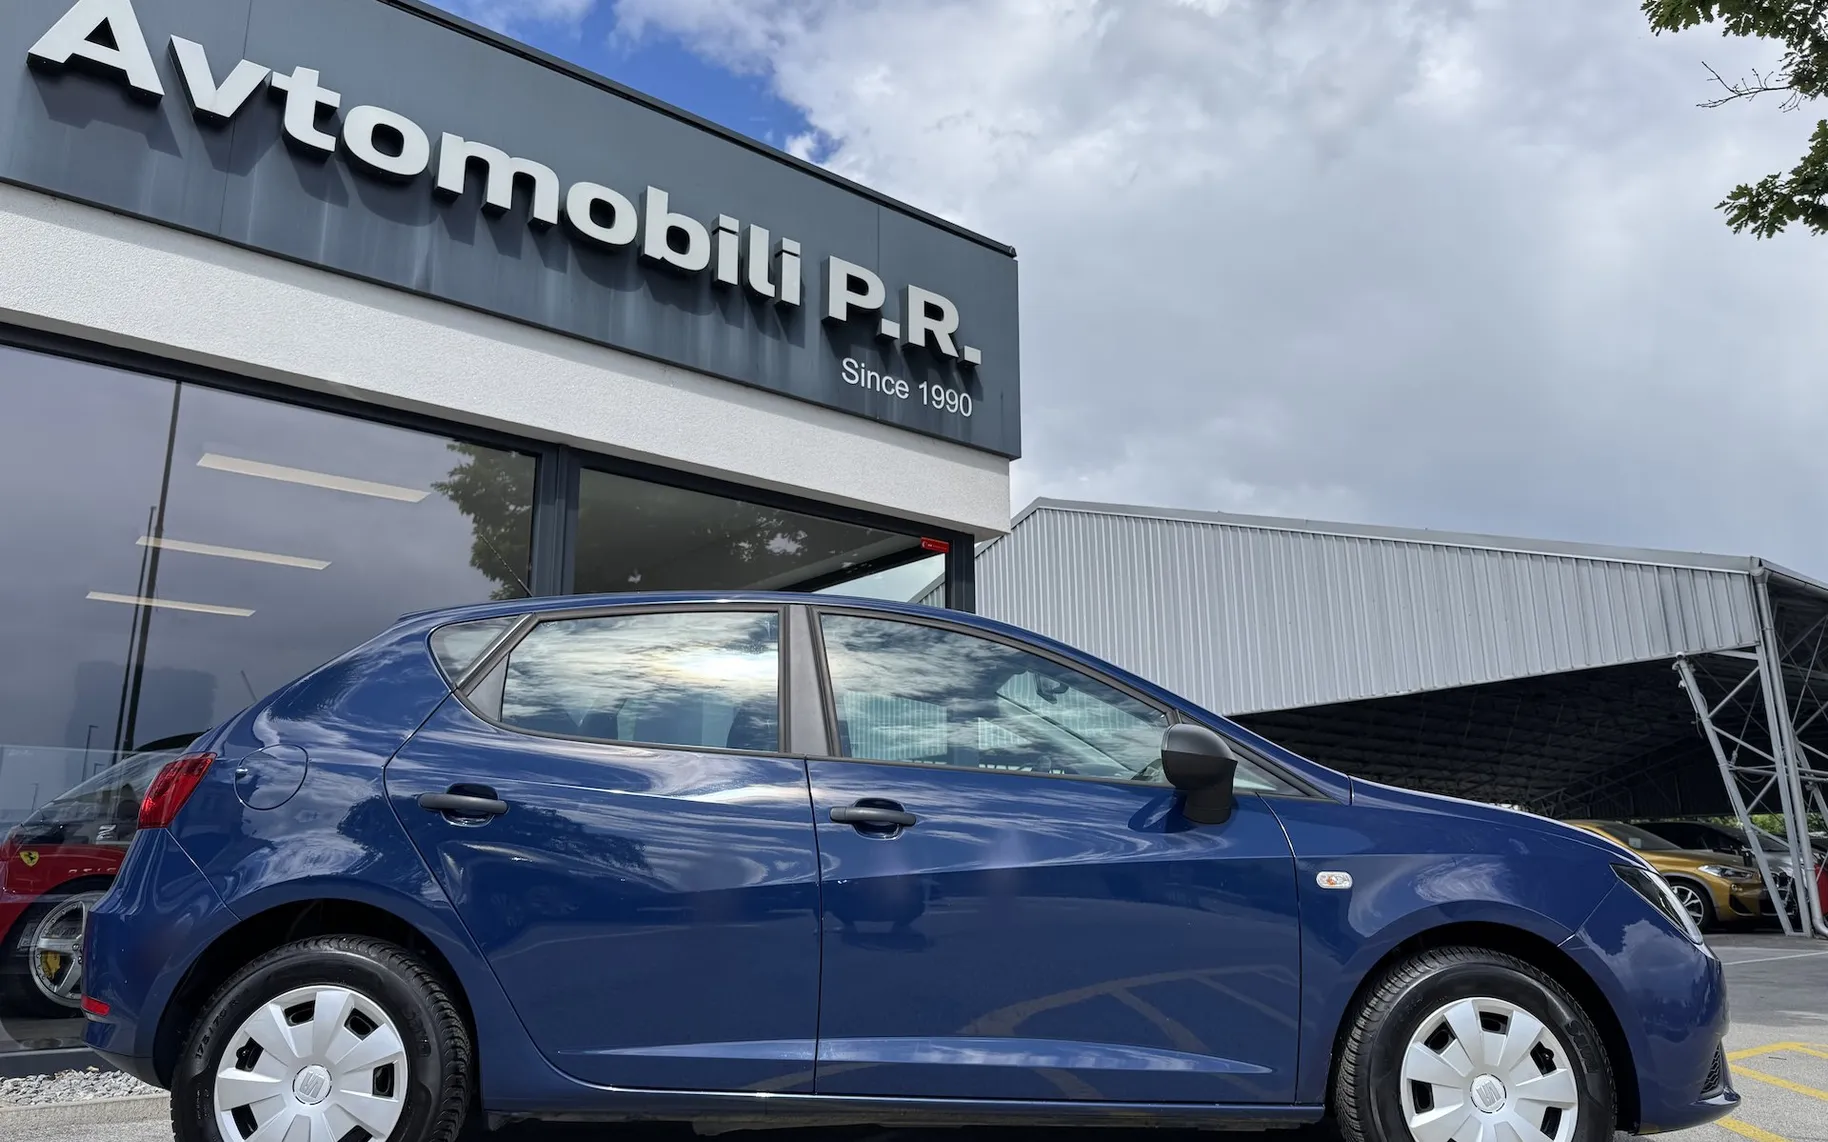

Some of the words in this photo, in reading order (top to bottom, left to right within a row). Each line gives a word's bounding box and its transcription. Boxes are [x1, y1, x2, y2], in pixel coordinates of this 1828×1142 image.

[28, 0, 801, 307] Avtomobili
[824, 254, 982, 367] P.R.
[841, 357, 910, 399] Since
[918, 381, 973, 417] 1990
